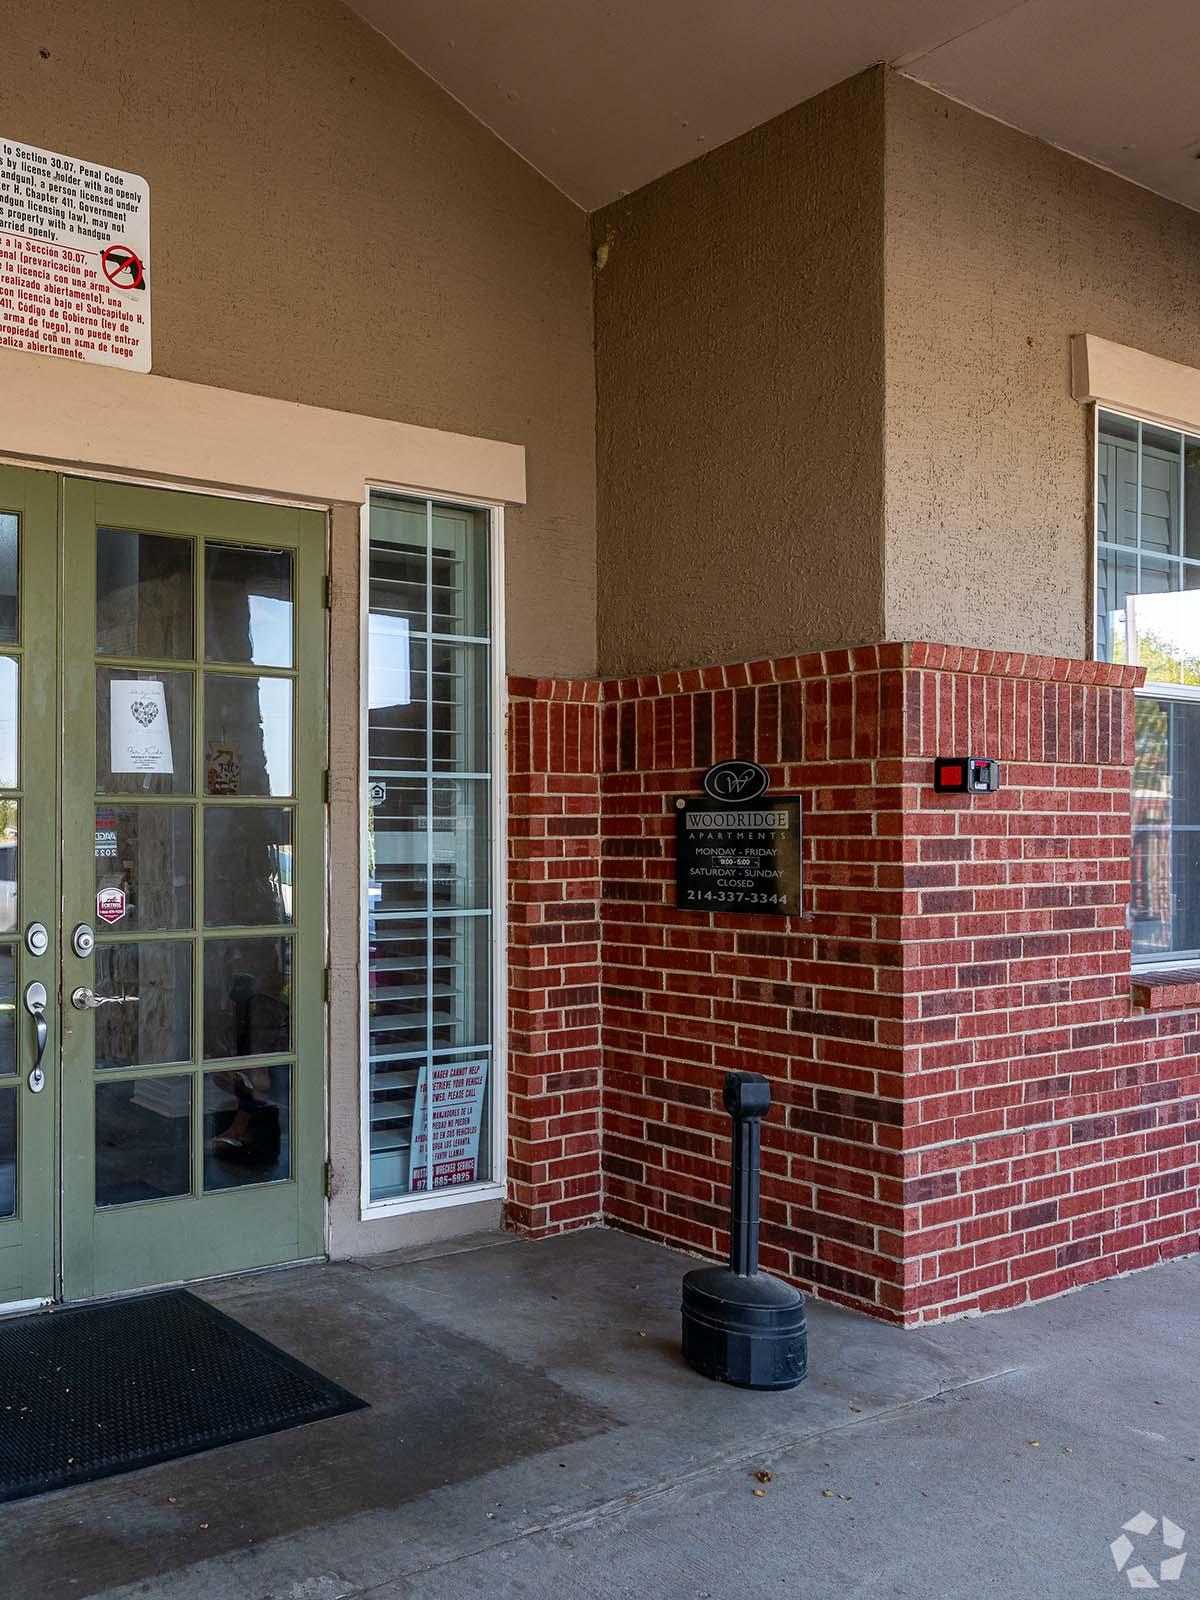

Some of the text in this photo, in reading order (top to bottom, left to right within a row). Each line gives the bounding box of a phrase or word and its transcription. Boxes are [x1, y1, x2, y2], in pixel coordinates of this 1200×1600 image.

[3, 144, 13, 156] to
[15, 147, 48, 165] Section
[79, 165, 102, 180] Penal
[104, 172, 124, 186] Code
[6, 157, 17, 171] by
[21, 161, 51, 179] license
[54, 170, 81, 186] holder
[84, 179, 102, 192] with
[103, 185, 114, 196] an
[115, 188, 142, 204] openly
[25, 187, 58, 205] Chapter
[78, 201, 127, 222] Government
[40, 180, 45, 189] a
[48, 183, 77, 197] person
[79, 189, 114, 207] licensed
[116, 200, 139, 213] under
[7, 208, 45, 226] property
[47, 217, 66, 231] with
[68, 224, 74, 233] a
[77, 224, 111, 242] handgun
[27, 200, 65, 220] licensing
[91, 218, 109, 231] may
[111, 222, 125, 234] not
[5, 238, 11, 247] a
[13, 238, 22, 250] la
[27, 226, 59, 242] openly.
[5, 261, 14, 273] la
[16, 264, 51, 281] licencia
[53, 274, 69, 285] con
[71, 277, 87, 289] una
[89, 282, 110, 294] arma
[83, 268, 98, 280] por
[0, 274, 41, 290] realizado
[107, 297, 122, 308] una
[17, 288, 51, 305] licencia
[54, 296, 72, 310] bajo
[75, 301, 83, 312] el
[3, 312, 25, 324] arma
[28, 315, 39, 327] de
[74, 326, 85, 336] no
[87, 329, 112, 341] puede
[114, 334, 140, 346] entrar
[49, 307, 59, 319] de
[62, 310, 98, 326] Gobierno
[101, 317, 117, 332] (ley
[119, 322, 129, 333] de
[26, 340, 86, 360] abiertamente.
[42, 332, 58, 343] con
[60, 335, 71, 345] un
[74, 338, 95, 350] arma
[98, 341, 108, 352] de
[110, 343, 134, 358] fuego
[688, 813, 786, 827] WOODRIDGE
[689, 832, 786, 840] APARTMENTS
[695, 848, 736, 856] MONDAY
[745, 848, 778, 857] FRIDAY
[689, 868, 736, 876] SATURDAY
[744, 869, 784, 878] SUNDAY
[717, 879, 754, 888] CLOSED
[687, 890, 787, 904] 214-337-3344
[432, 1080, 451, 1091] ETRIEVE
[416, 1171, 470, 1189] 97-685-6925
